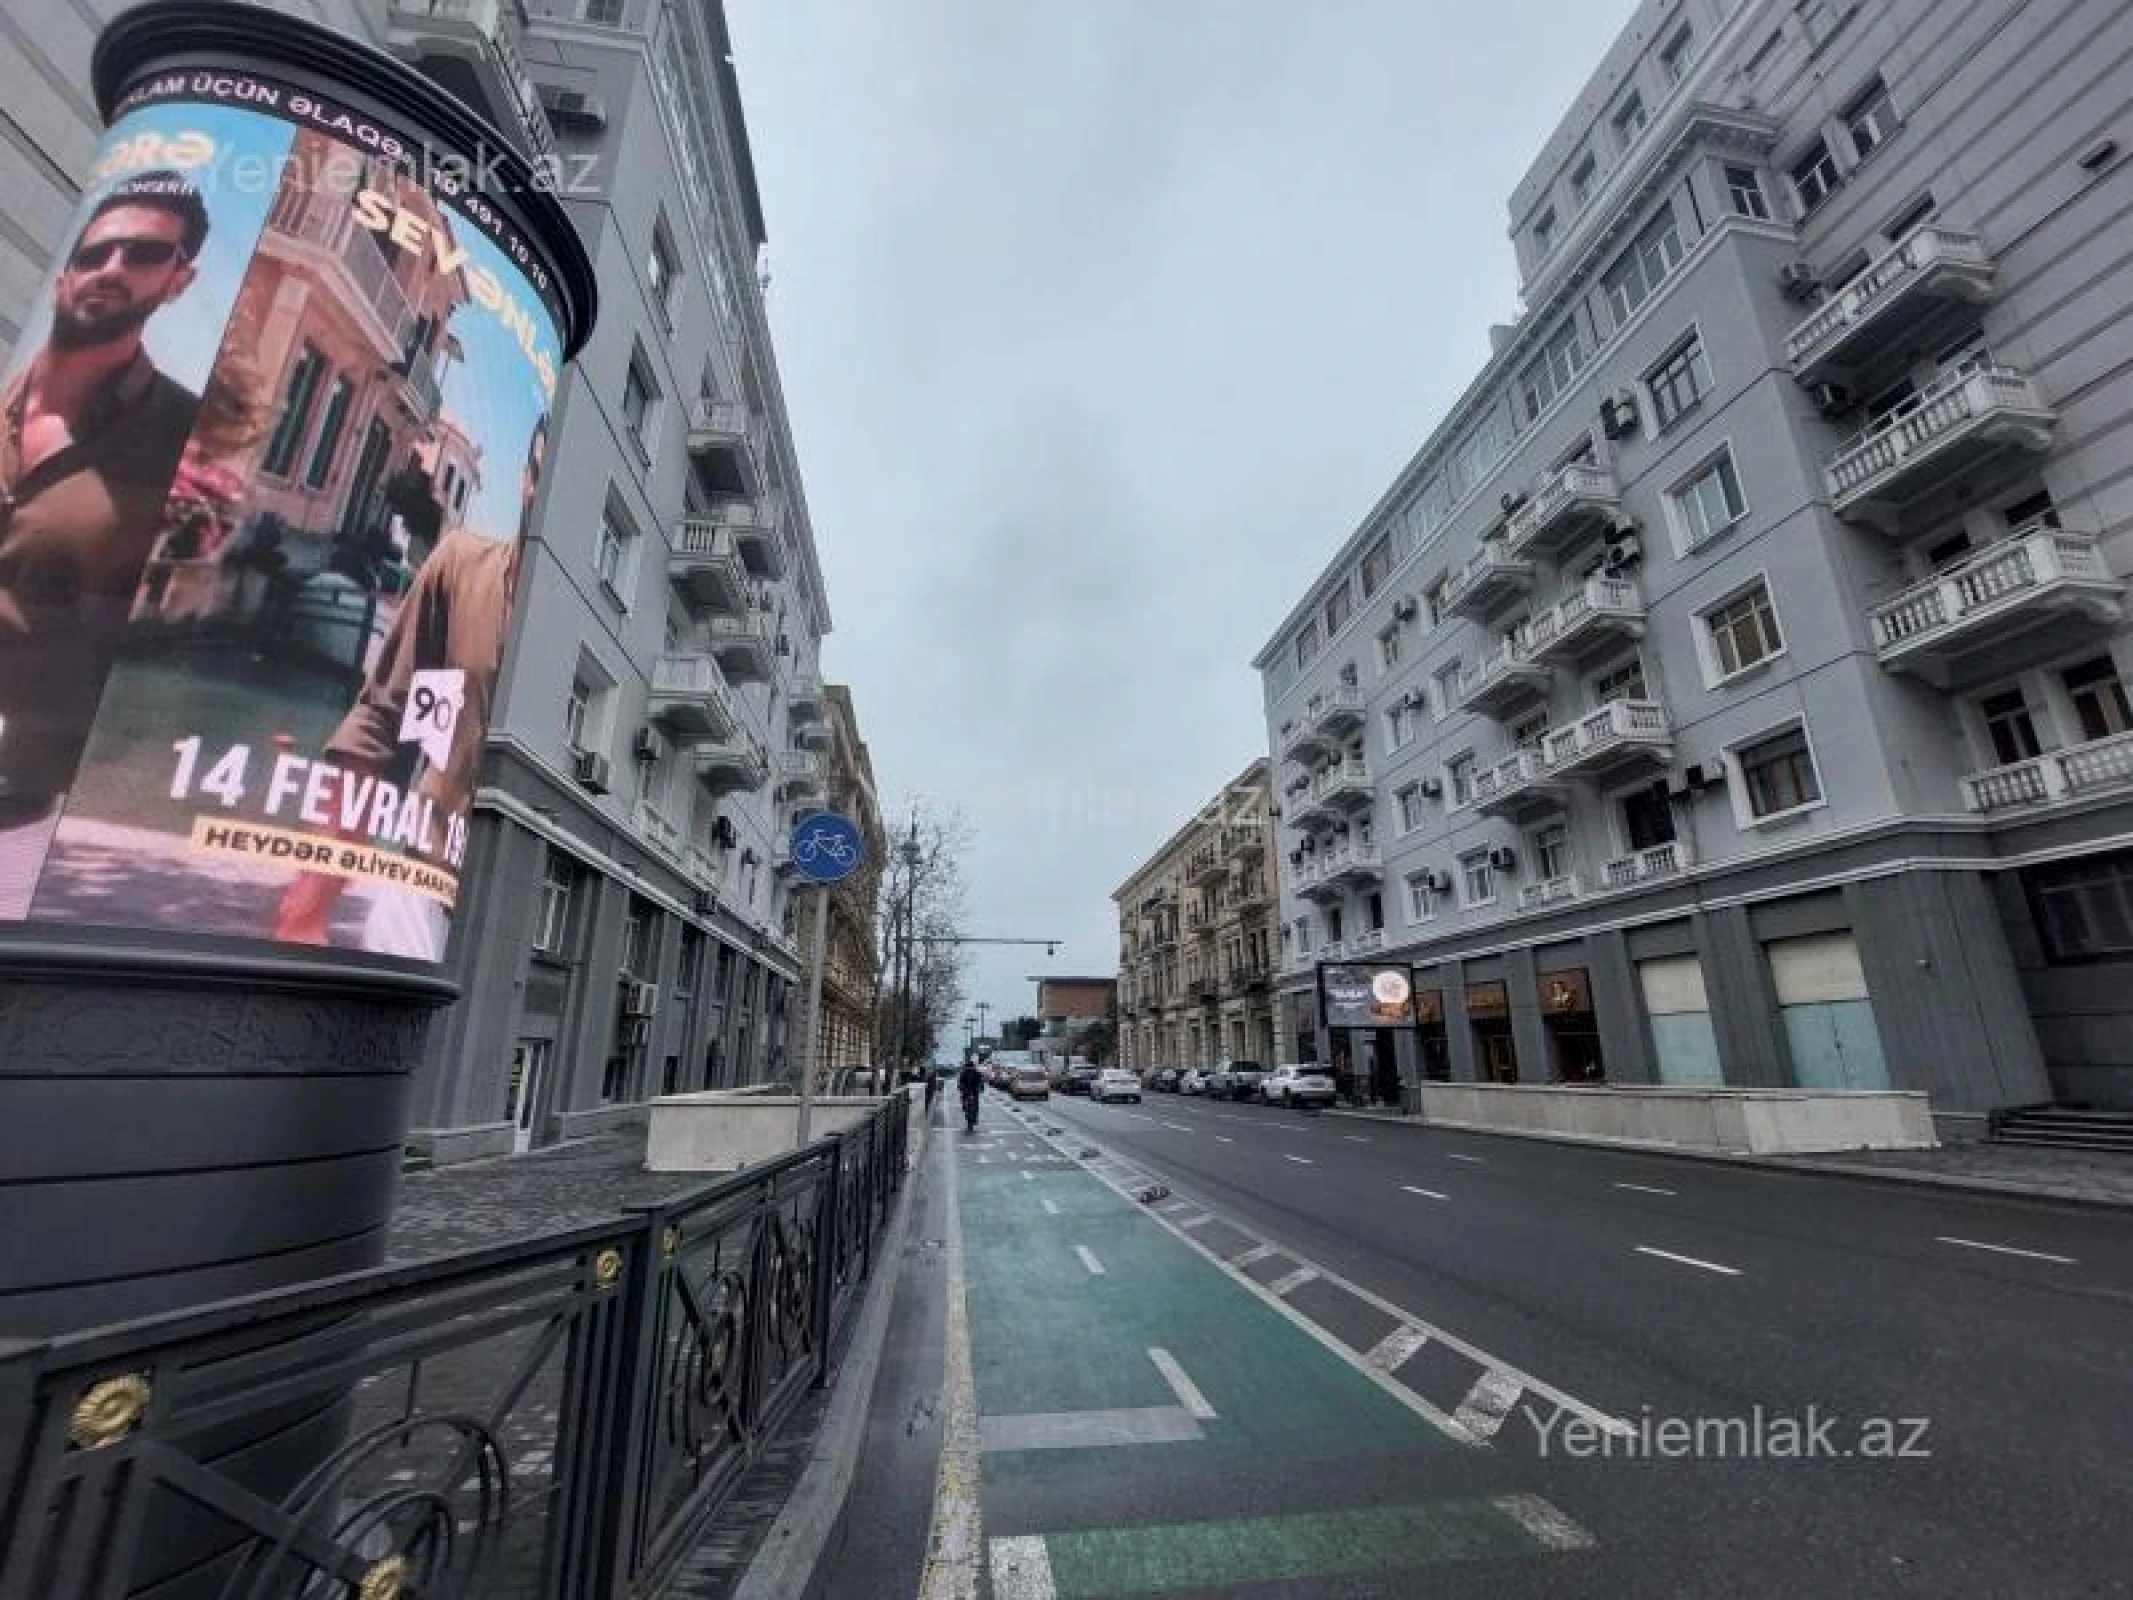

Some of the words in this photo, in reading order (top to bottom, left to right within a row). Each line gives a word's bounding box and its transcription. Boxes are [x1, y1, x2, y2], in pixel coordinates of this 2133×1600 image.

[415, 687, 452, 733] 90
[169, 733, 251, 807] 14
[263, 753, 433, 853] FEVRAL
[204, 826, 335, 866] HEYDƏR
[339, 850, 411, 882] ƏLİYEV
